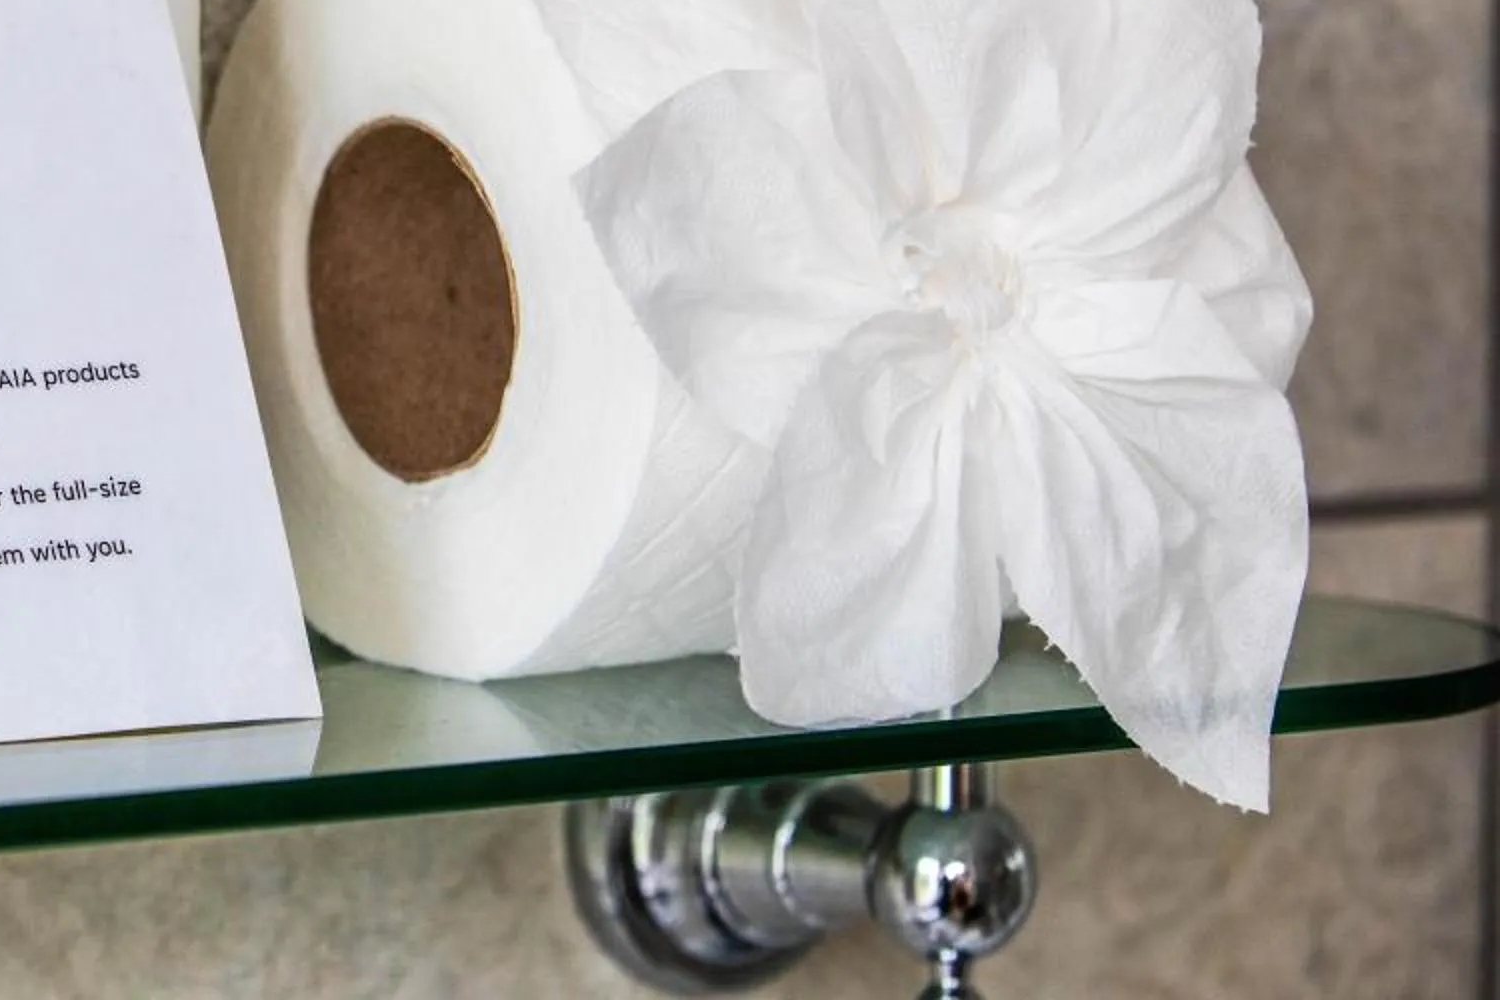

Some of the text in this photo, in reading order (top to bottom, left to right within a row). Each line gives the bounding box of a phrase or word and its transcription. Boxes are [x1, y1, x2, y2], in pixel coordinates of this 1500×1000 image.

[41, 361, 141, 391] products
[9, 483, 47, 506] the
[51, 475, 143, 502] full-size
[29, 538, 81, 563] with
[84, 538, 133, 564] you.
